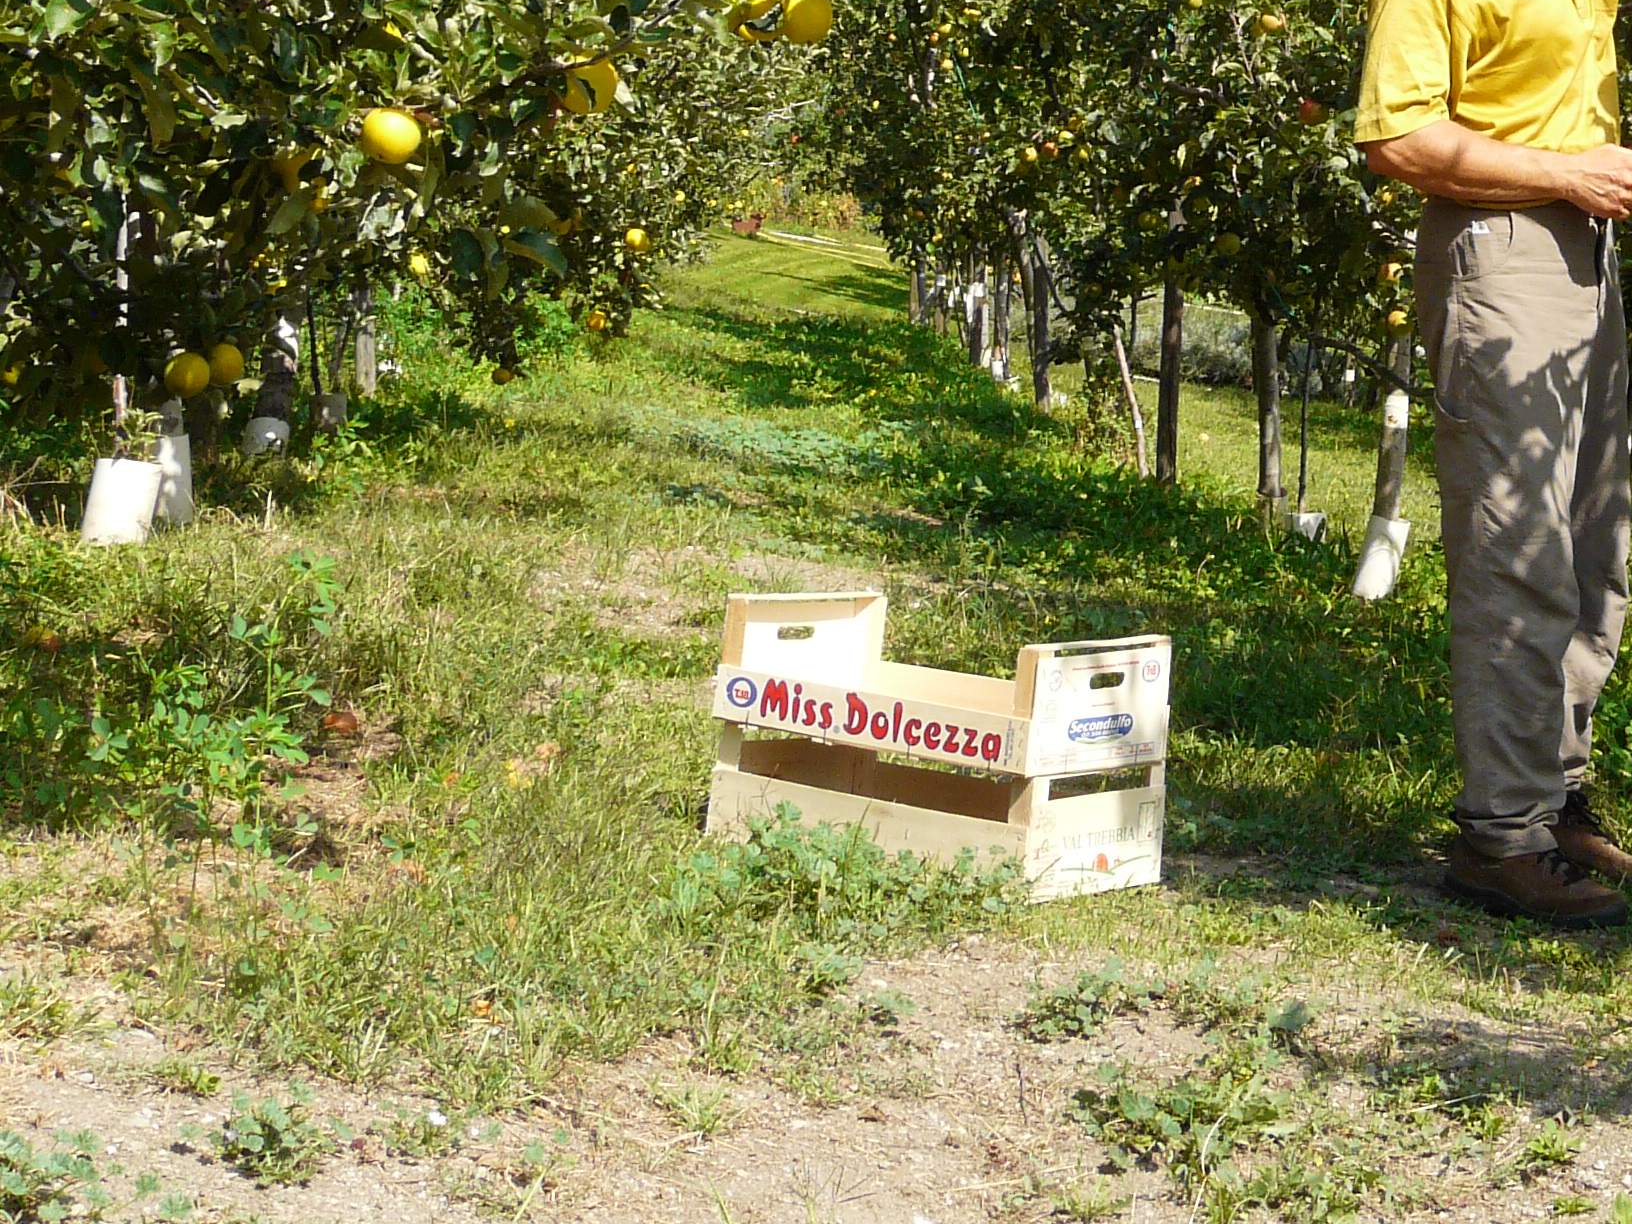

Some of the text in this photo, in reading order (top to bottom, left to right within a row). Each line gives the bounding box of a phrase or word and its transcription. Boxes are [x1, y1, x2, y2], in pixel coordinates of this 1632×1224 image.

[759, 678, 834, 730] Miss
[843, 691, 1003, 763] Dolcezza
[1069, 715, 1132, 734] Secondulfo
[1062, 826, 1135, 850] VAL TREBBIA
